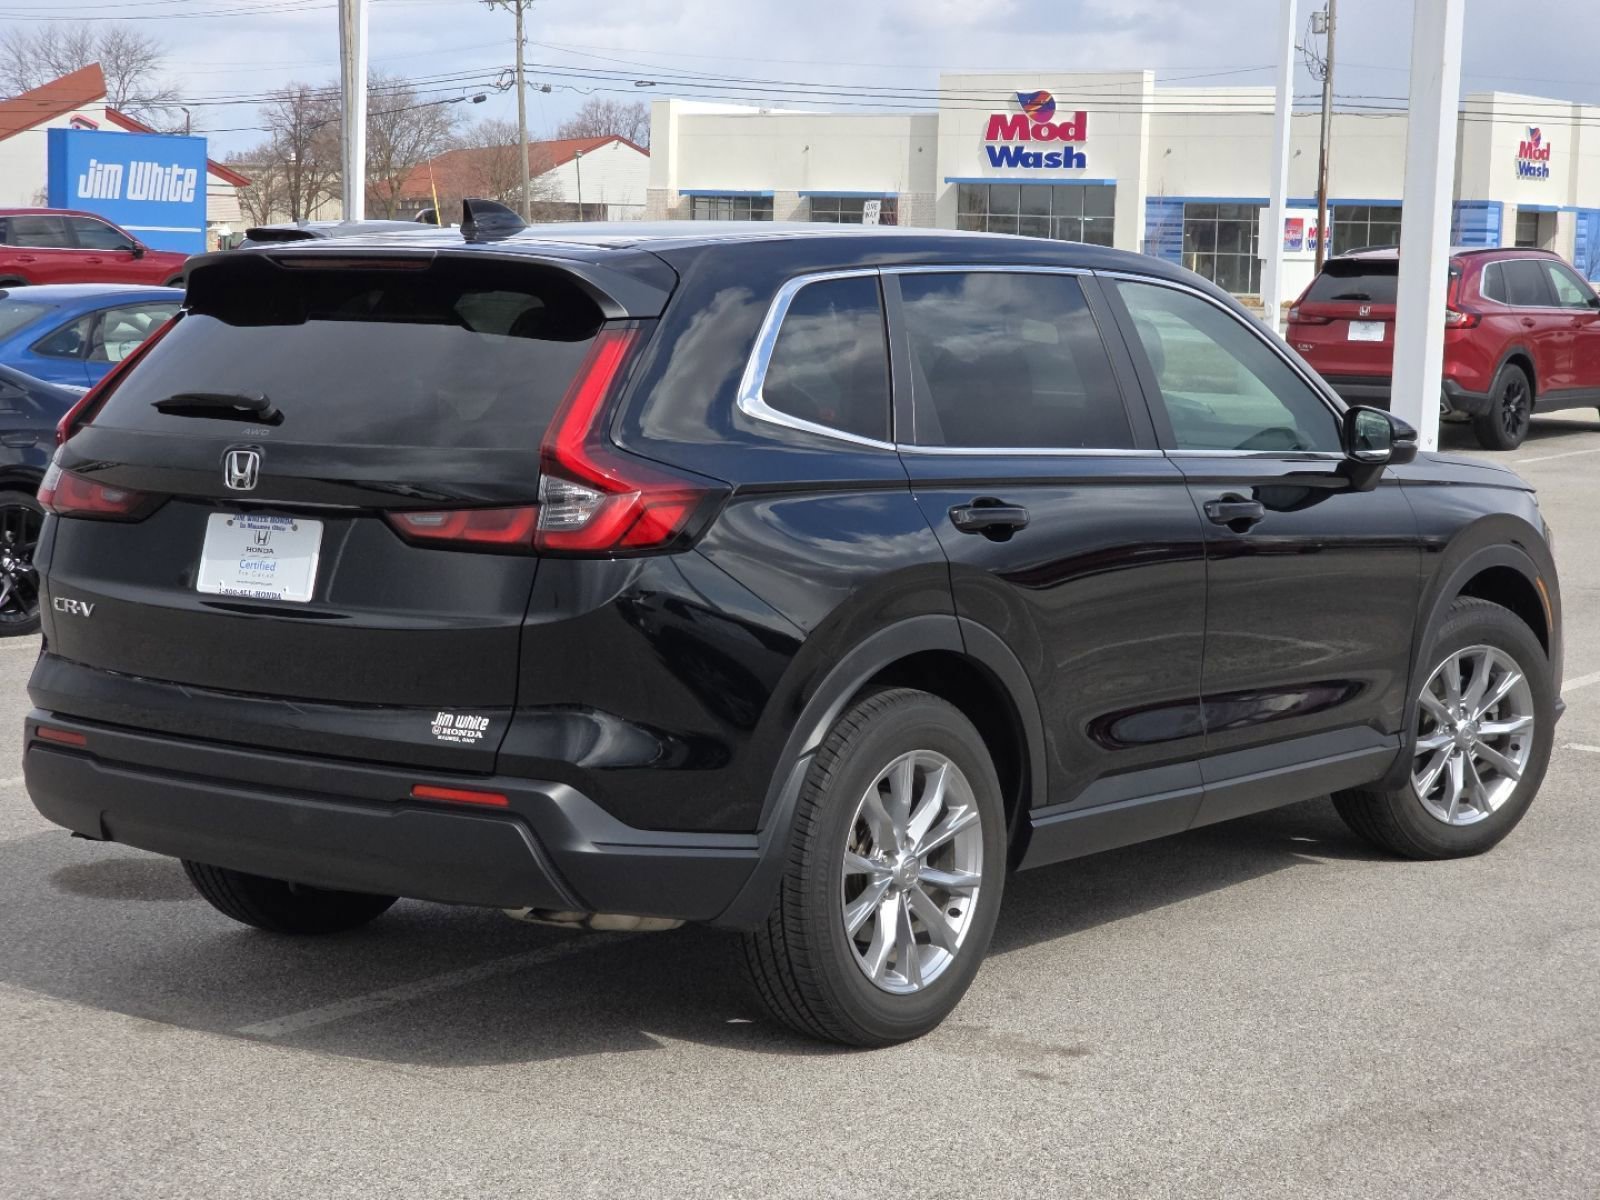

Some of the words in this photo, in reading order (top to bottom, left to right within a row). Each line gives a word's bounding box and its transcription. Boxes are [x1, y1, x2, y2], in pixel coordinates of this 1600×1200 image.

[985, 111, 1087, 141] Mod
[985, 145, 1086, 168] Wash
[1519, 141, 1550, 161] Mod
[1518, 161, 1549, 178] Wash
[78, 159, 123, 199] Jim
[126, 161, 197, 203] White
[241, 428, 270, 436] AWD
[246, 546, 274, 554] HONDA
[239, 559, 276, 571] Certified
[54, 597, 95, 617] CR-V
[431, 712, 454, 727] Jim
[441, 727, 483, 738] HONDA
